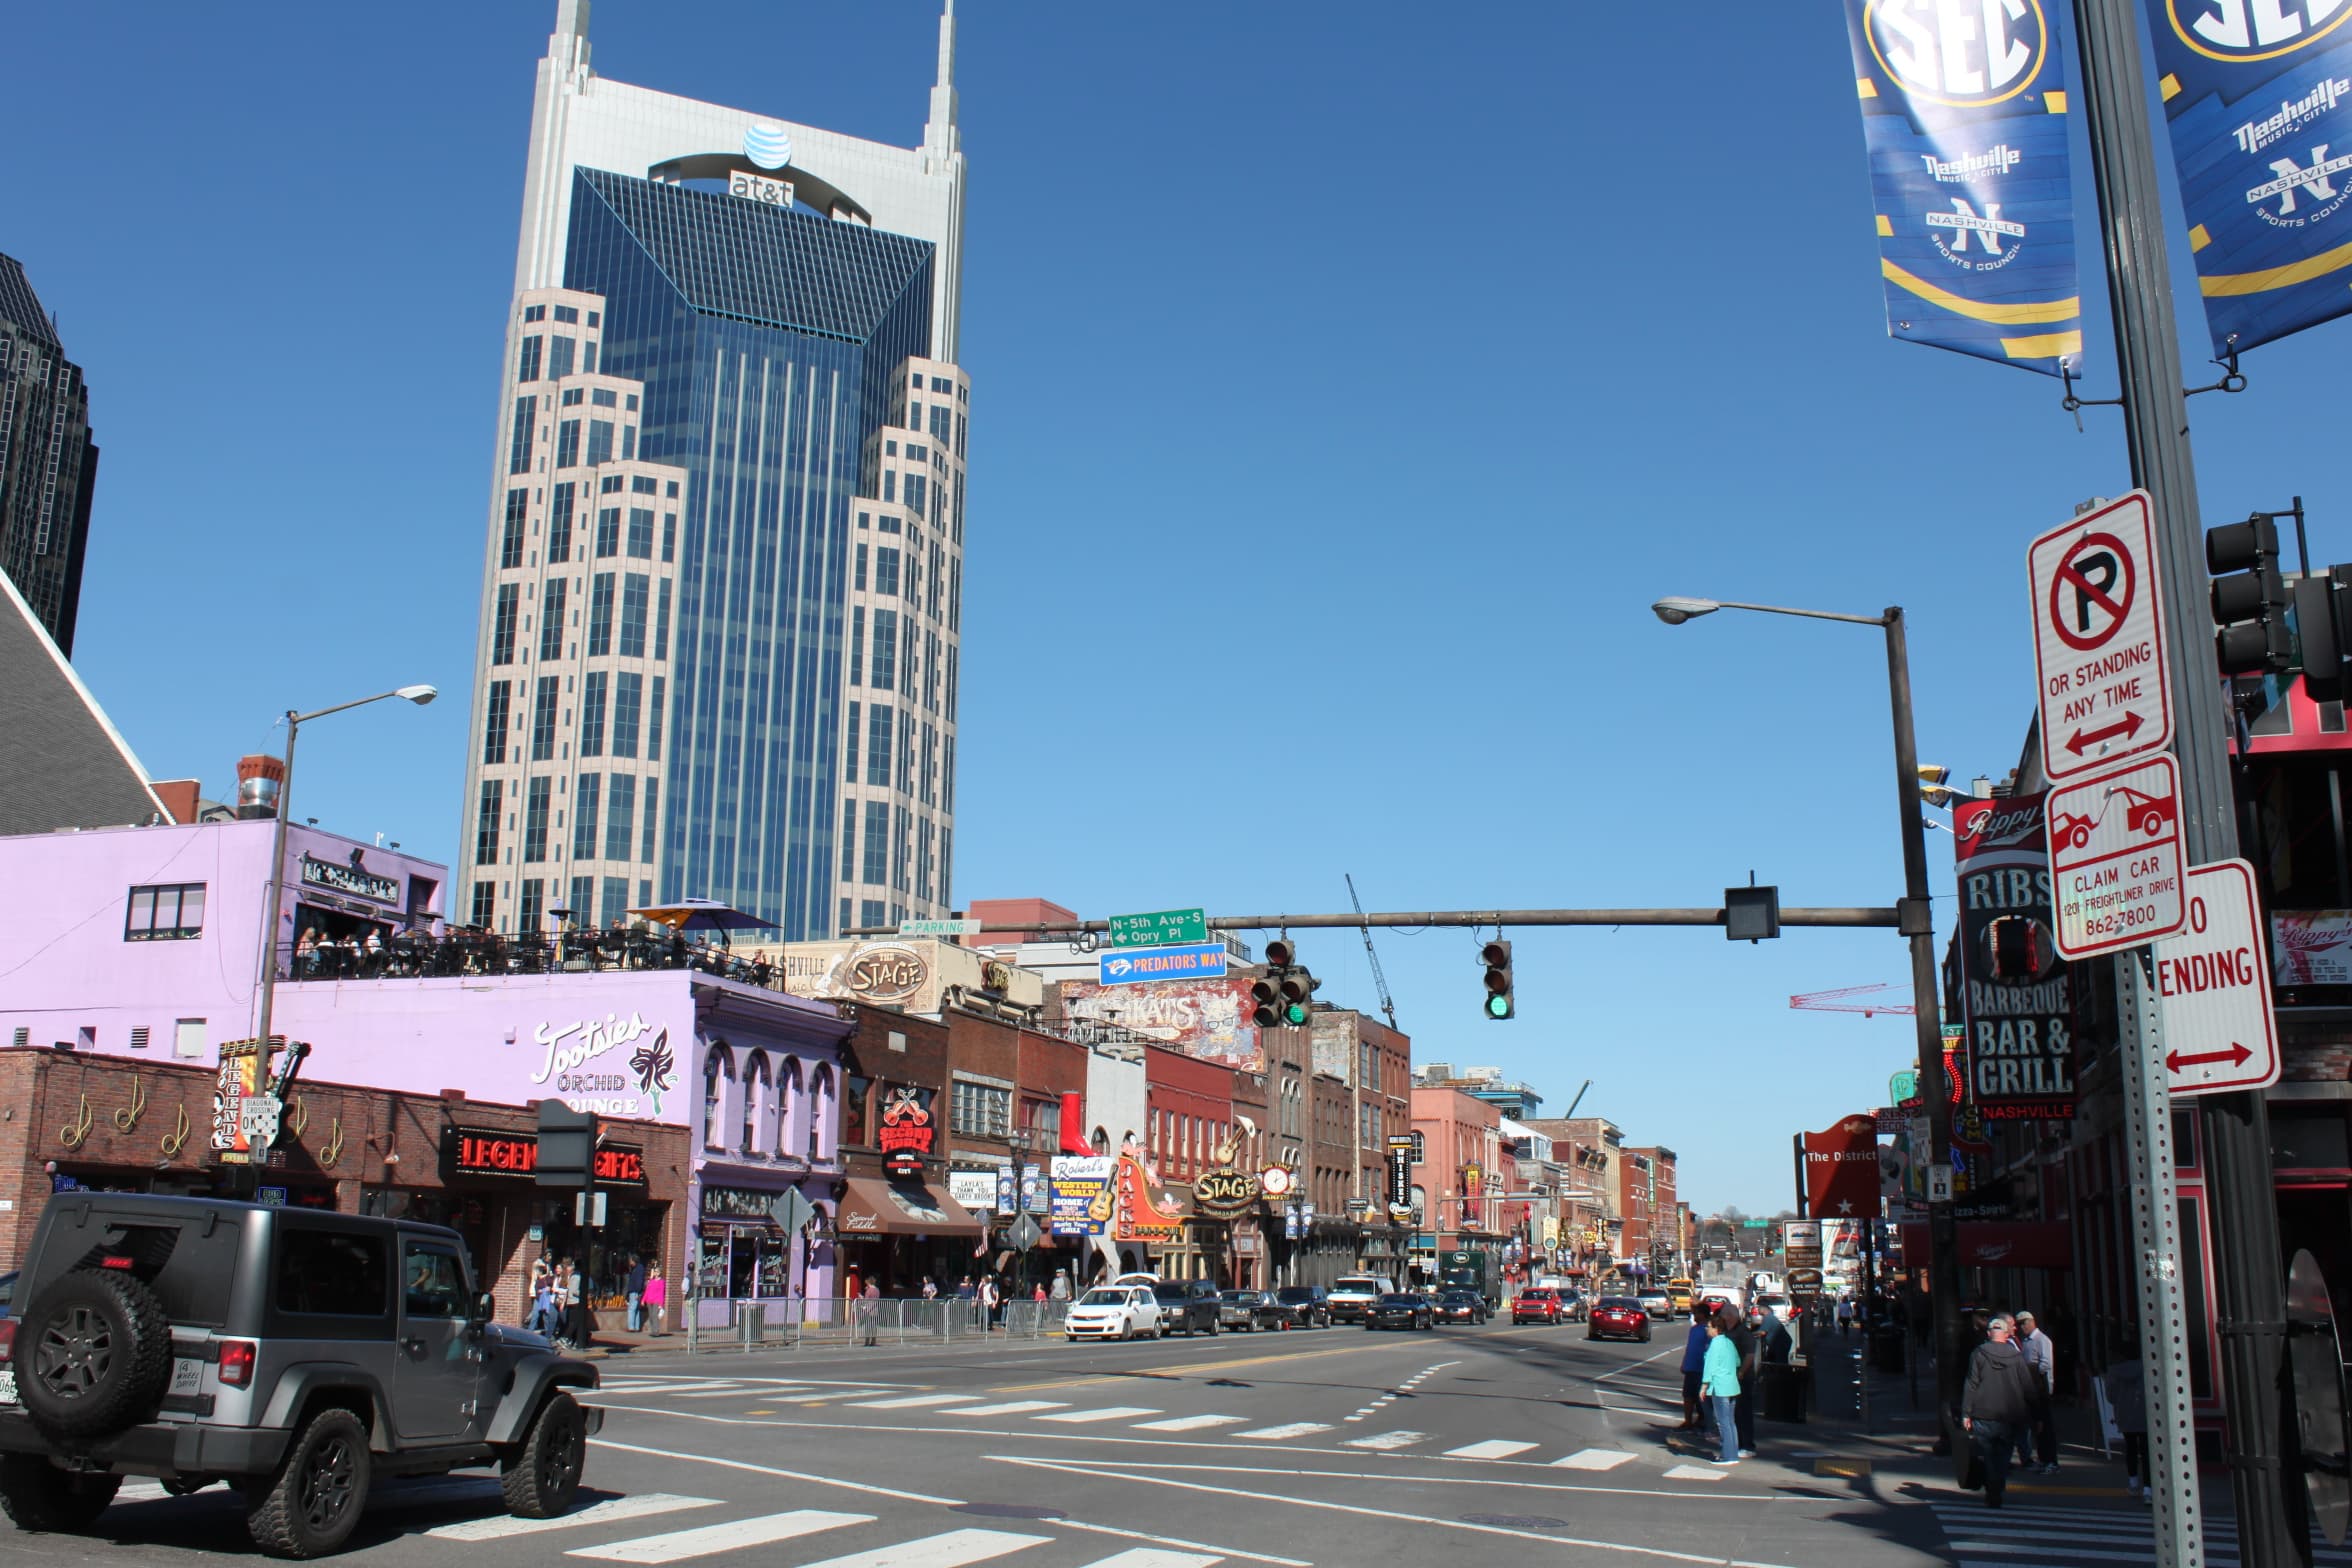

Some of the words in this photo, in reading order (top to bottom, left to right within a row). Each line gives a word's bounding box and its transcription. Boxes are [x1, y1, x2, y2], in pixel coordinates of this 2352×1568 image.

[2232, 78, 2350, 154] Nashville
[2258, 123, 2293, 149] MUSIC
[2303, 103, 2327, 123] CITY
[1921, 144, 2021, 182] Nashville
[1941, 174, 1970, 183] MUSIC
[1980, 167, 2003, 177] CITY
[733, 175, 792, 206] at&t
[2255, 207, 2305, 228] SPORTS
[2310, 177, 2352, 223] COUNC
[1928, 214, 2024, 235] NASHVILLE
[1931, 233, 1972, 270] SPORTS
[1976, 243, 2021, 271] COUNCIL
[2050, 673, 2070, 697] OR
[2076, 642, 2151, 687] STANDING
[2064, 694, 2096, 723] ANY
[2104, 677, 2142, 708] TIME
[2075, 867, 2119, 893] CLAIM
[2130, 856, 2160, 879] CAR
[1967, 868, 2050, 910] RIBS
[2063, 901, 2080, 917] 1201
[2085, 886, 2144, 911] FREIGHTLINER
[2149, 877, 2175, 896] DRIVE
[2086, 904, 2156, 936] 862-7800
[2189, 896, 2207, 934] O
[915, 921, 964, 933] PARKING
[1131, 931, 1160, 944] Opry
[1168, 928, 1182, 939] Pl
[1133, 954, 1197, 973] PREDATORS
[1200, 952, 1225, 968] WAY
[2158, 947, 2253, 997] ENDING
[852, 957, 922, 992] STAGE
[1970, 975, 2071, 1017] BARBEQUE
[530, 1011, 653, 1084] Tootsies
[1976, 1019, 2040, 1057] BAR
[2047, 1018, 2072, 1054] &
[557, 1074, 626, 1094] ORCHID
[1977, 1057, 2074, 1096] GRILL
[222, 1056, 240, 1149] LEGENDS
[246, 1099, 276, 1107] DIAGONAL
[246, 1106, 276, 1114] CROSSING
[568, 1097, 640, 1115] OUNGE
[1983, 1104, 2074, 1119] NASHVILLE
[242, 1116, 257, 1130] OK
[879, 1127, 933, 1141] SECOND
[880, 1139, 931, 1154] FIDDLE
[1807, 1152, 1830, 1162] The
[1834, 1150, 1877, 1162] District
[462, 1137, 538, 1171] LEGEN
[594, 1151, 641, 1180] GIFTS
[1056, 1159, 1104, 1181] Robert's
[1220, 1168, 1233, 1176] THE
[1396, 1148, 1407, 1204] WHISKEY
[1052, 1181, 1102, 1189] WESTERN
[1060, 1189, 1096, 1197] WORLD
[1197, 1173, 1257, 1201] STAGE
[1053, 1198, 1084, 1206] HOME
[846, 1211, 878, 1221] Second
[846, 1220, 877, 1230] Fiddle
[176, 1372, 200, 1380] WHEEL
[181, 1362, 190, 1372] 4
[176, 1379, 198, 1389] DRIVE
